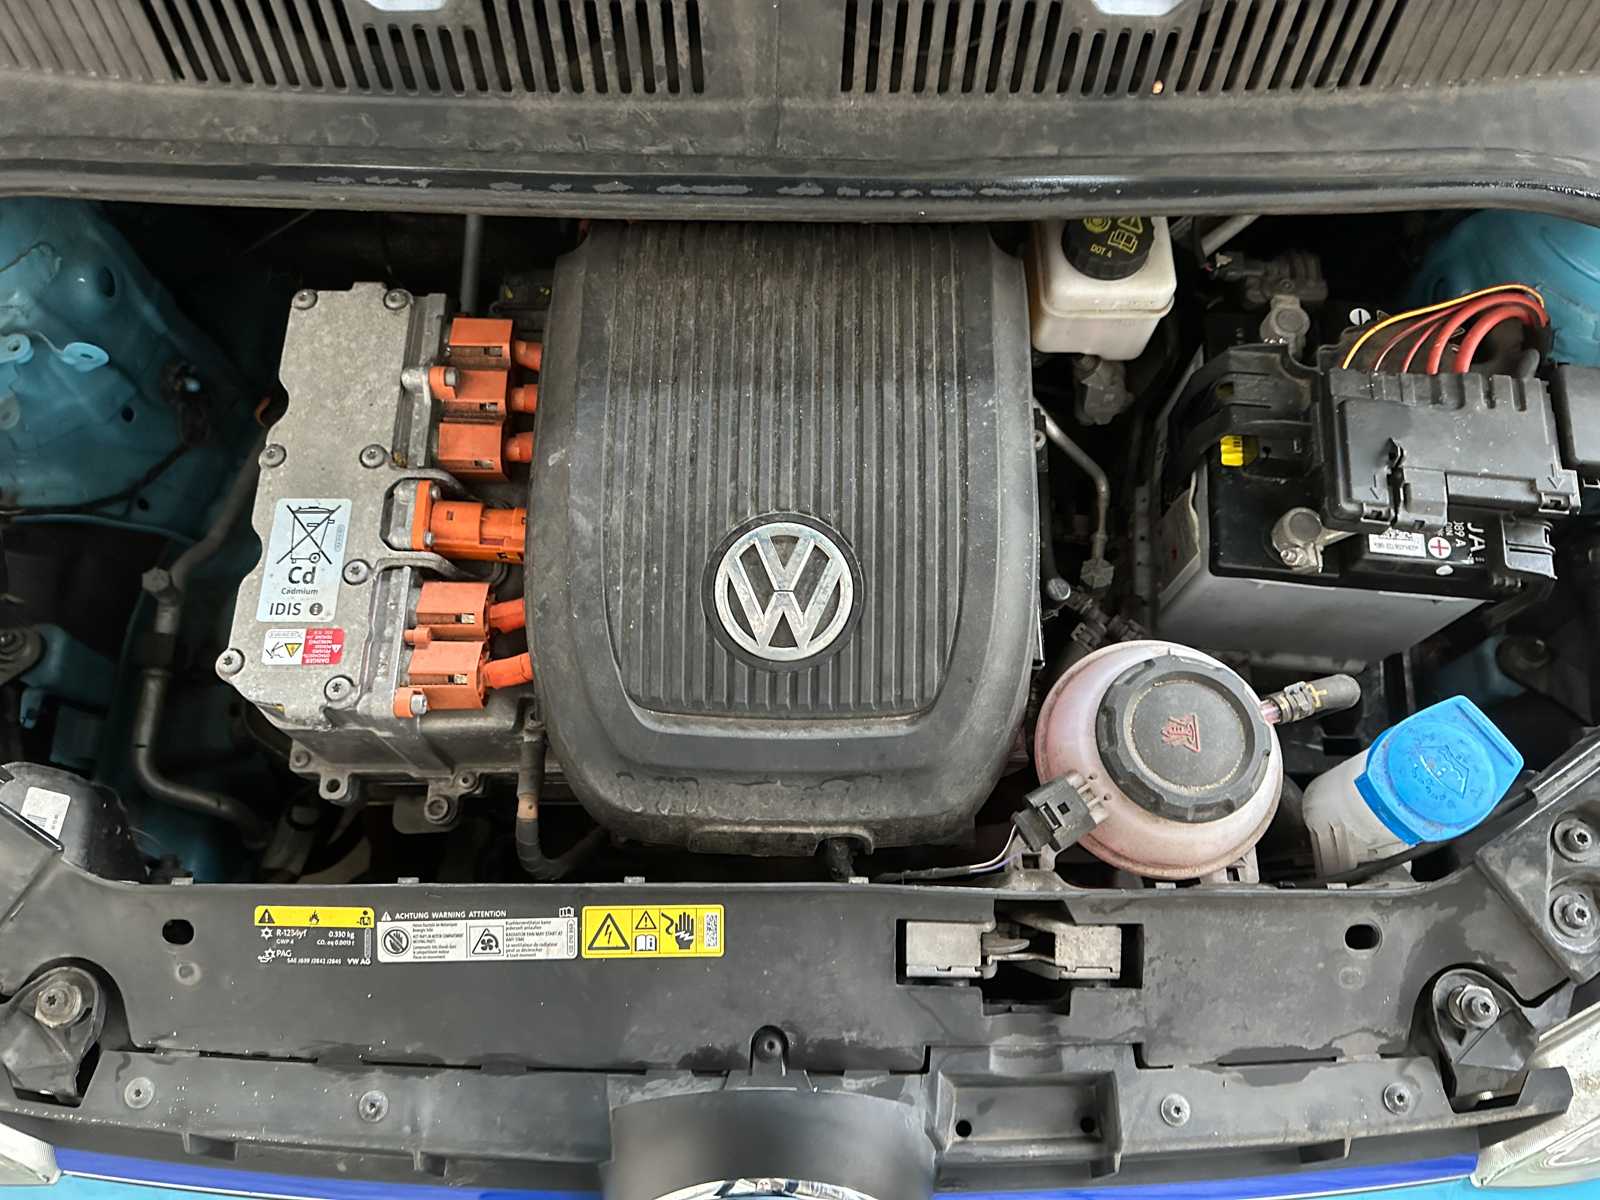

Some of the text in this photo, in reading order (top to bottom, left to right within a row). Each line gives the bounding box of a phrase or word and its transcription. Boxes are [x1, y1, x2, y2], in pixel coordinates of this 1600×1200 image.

[1090, 244, 1106, 255] DOT
[288, 566, 316, 585] Cd
[281, 587, 319, 596] Cadmium
[715, 523, 853, 660] VW
[269, 602, 302, 616] IDIS
[395, 910, 506, 920] ACHTUNG WARNING ATTENTION
[347, 930, 355, 939] kg
[276, 949, 292, 957] PAG
